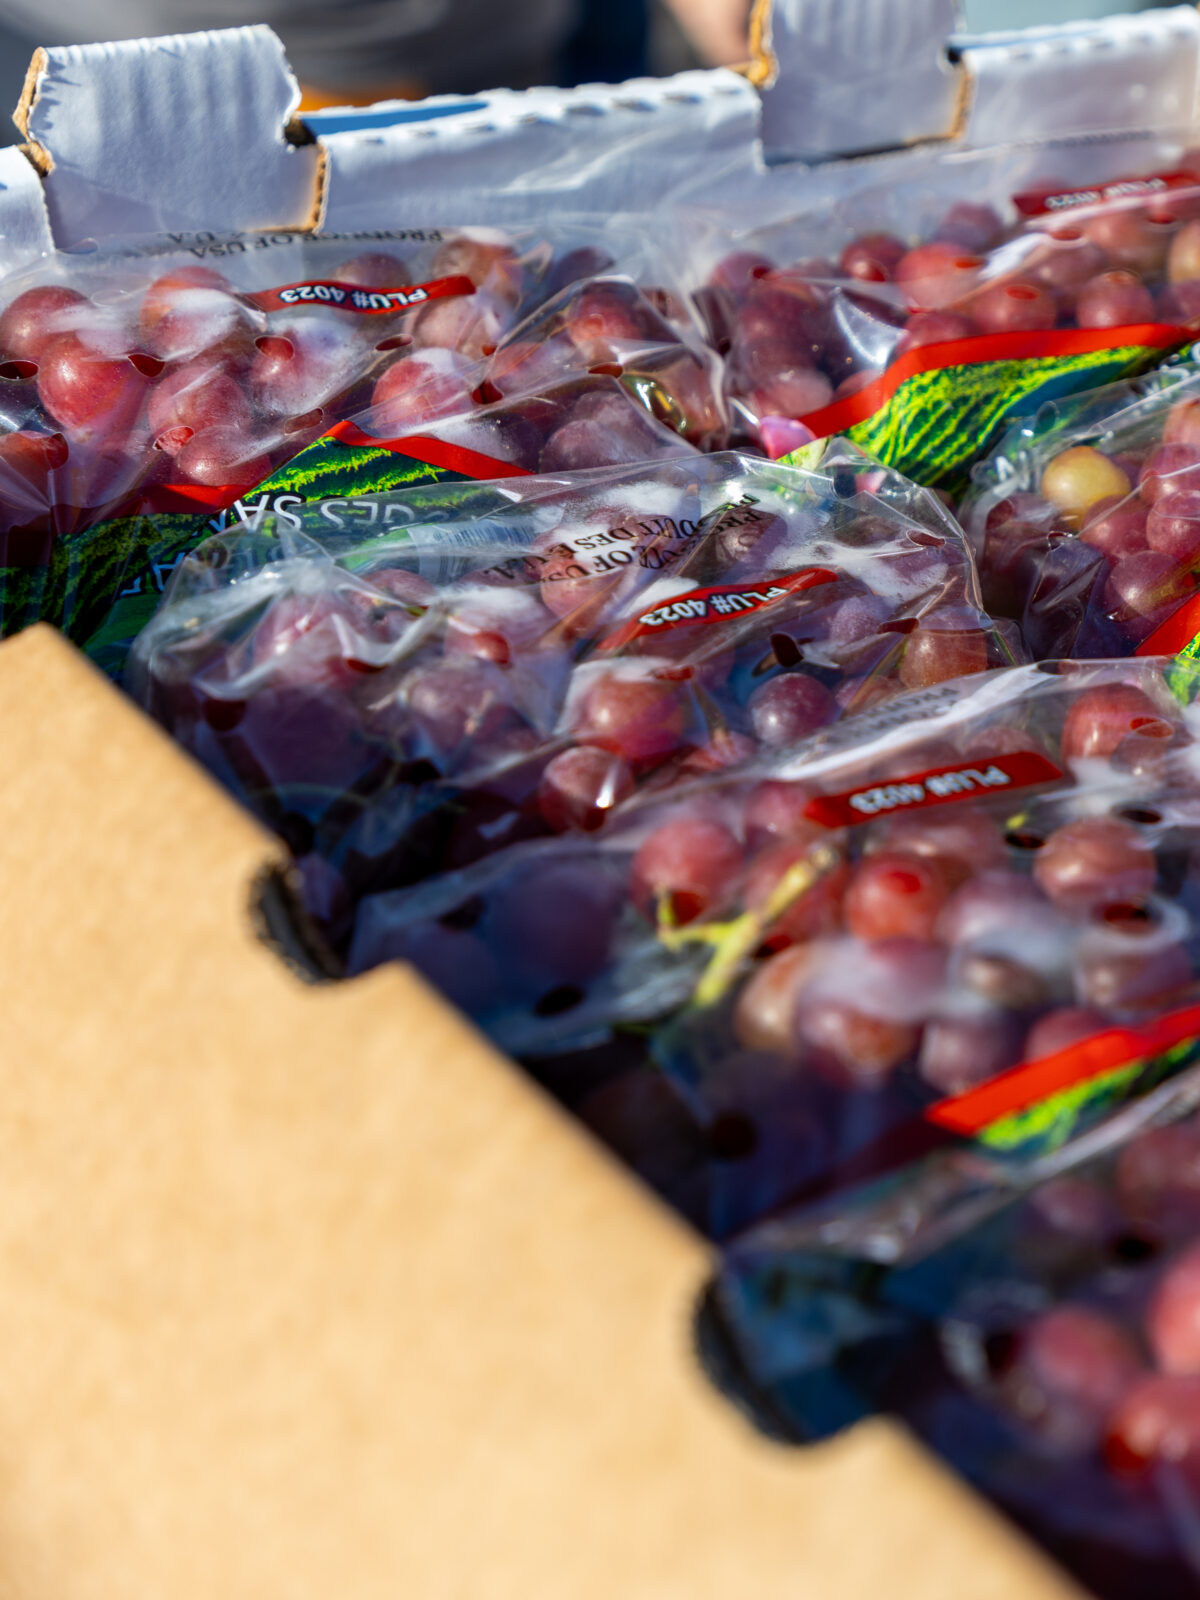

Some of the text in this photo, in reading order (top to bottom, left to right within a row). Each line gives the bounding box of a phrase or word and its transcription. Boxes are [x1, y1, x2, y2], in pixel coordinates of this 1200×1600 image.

[187, 240, 247, 260] USA
[279, 284, 429, 309] PLU# 4023
[574, 526, 633, 550] DES
[588, 548, 634, 574] OF
[638, 585, 792, 627] PLU# 4023
